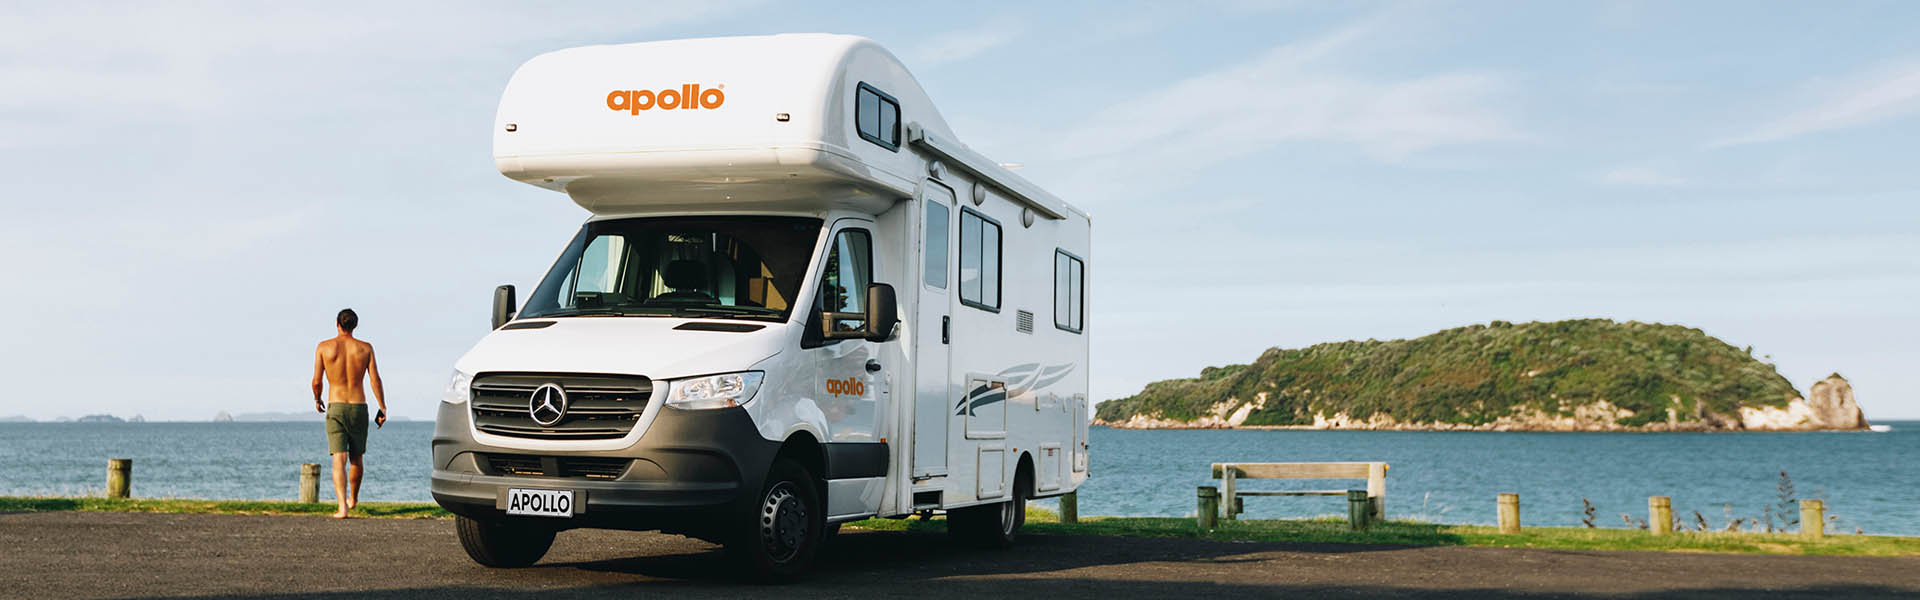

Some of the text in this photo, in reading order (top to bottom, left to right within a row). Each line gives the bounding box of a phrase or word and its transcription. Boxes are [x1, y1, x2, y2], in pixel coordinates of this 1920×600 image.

[606, 83, 725, 116] apollo
[826, 377, 864, 398] apollo
[510, 493, 570, 513] APOLLO
